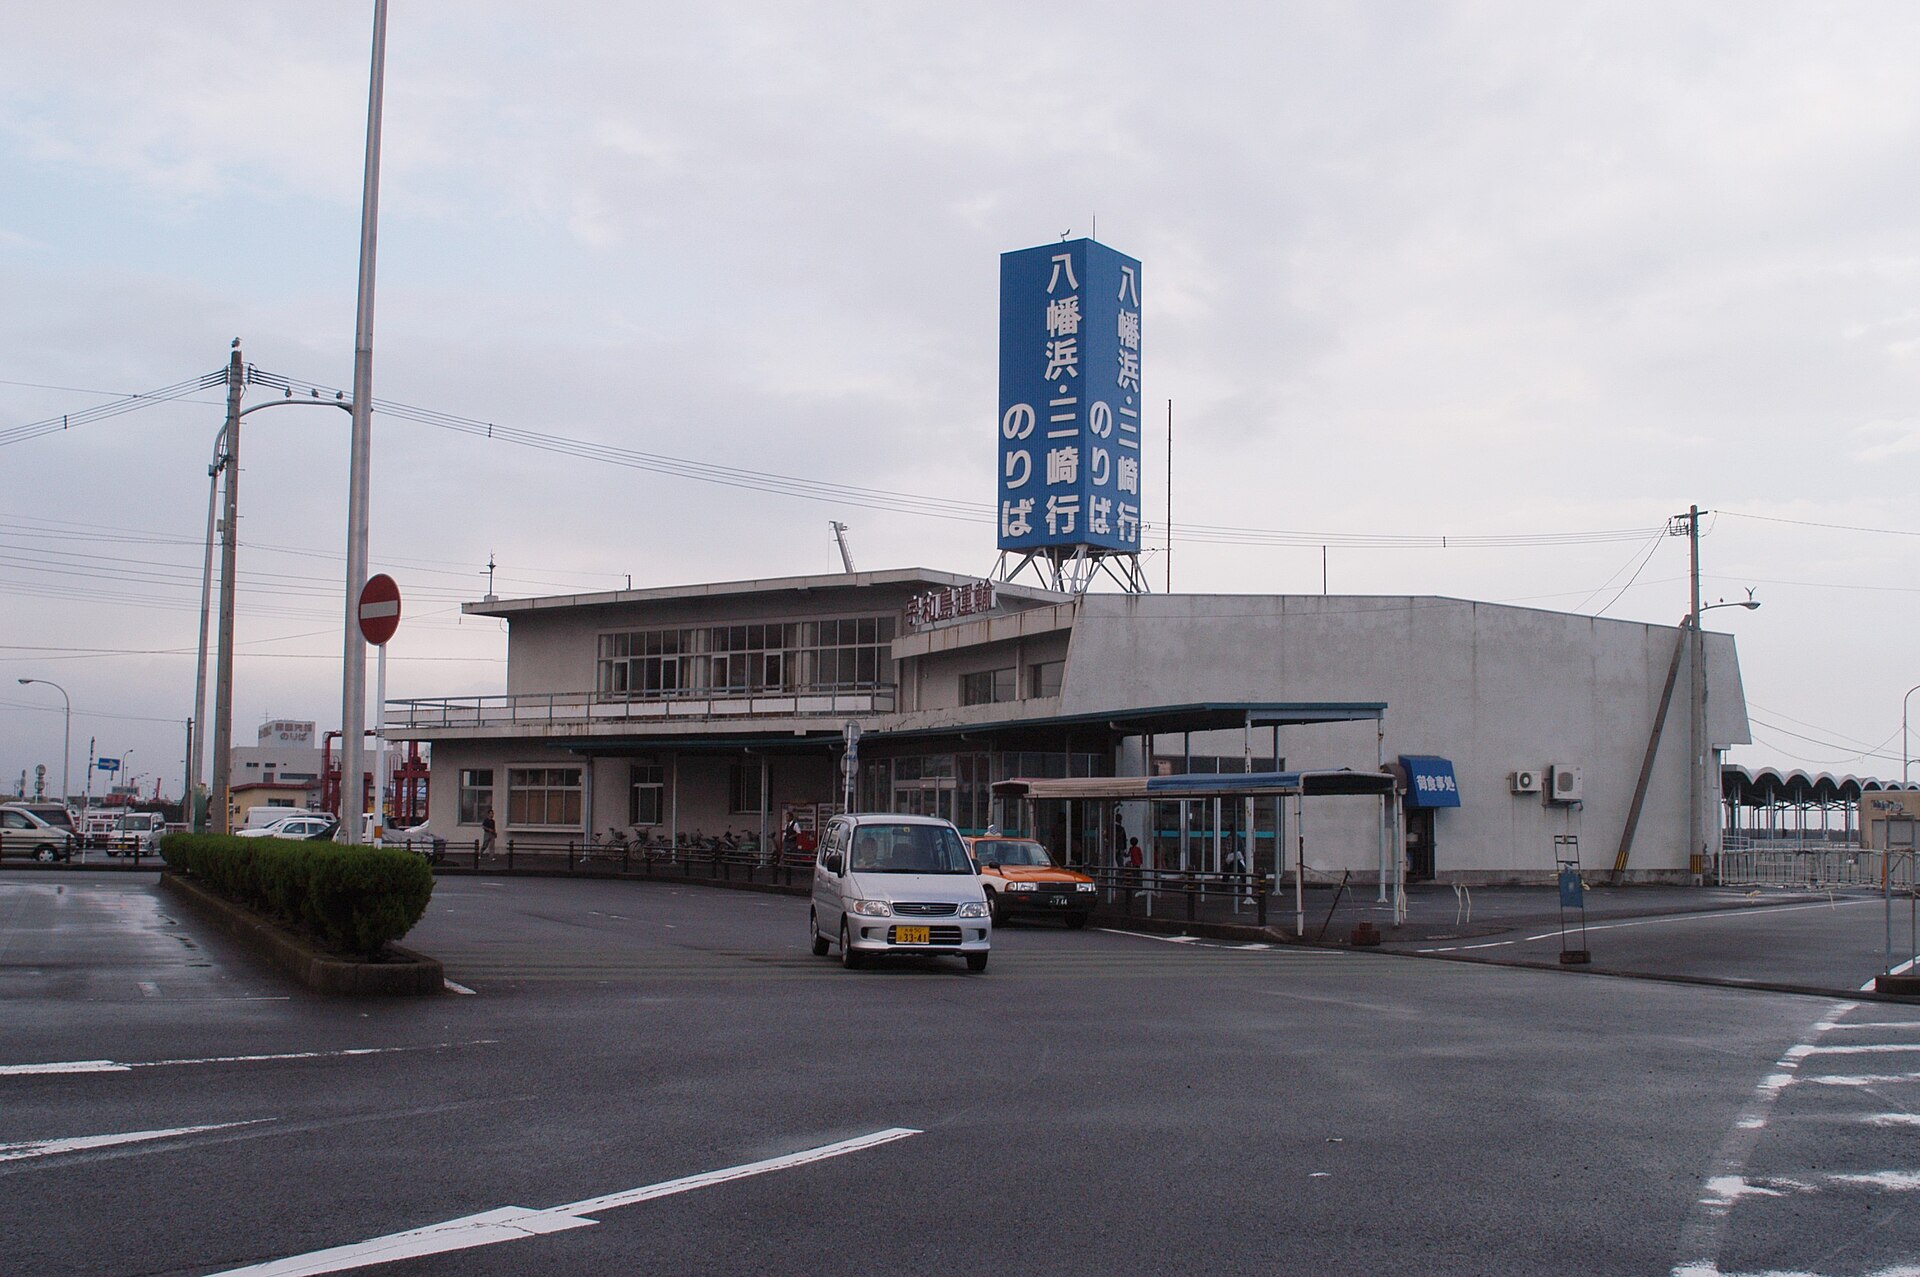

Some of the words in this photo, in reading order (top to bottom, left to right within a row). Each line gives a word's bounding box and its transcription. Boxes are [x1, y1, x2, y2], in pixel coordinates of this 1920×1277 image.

[1045, 252, 1082, 536] 八幡浜・三崎行
[1117, 265, 1141, 543] 八幡浜・三崎行
[1002, 402, 1036, 538] のりば
[1089, 401, 1113, 536] のりば
[906, 577, 996, 626] 宇和島運輸
[1416, 774, 1456, 792] 御食事処
